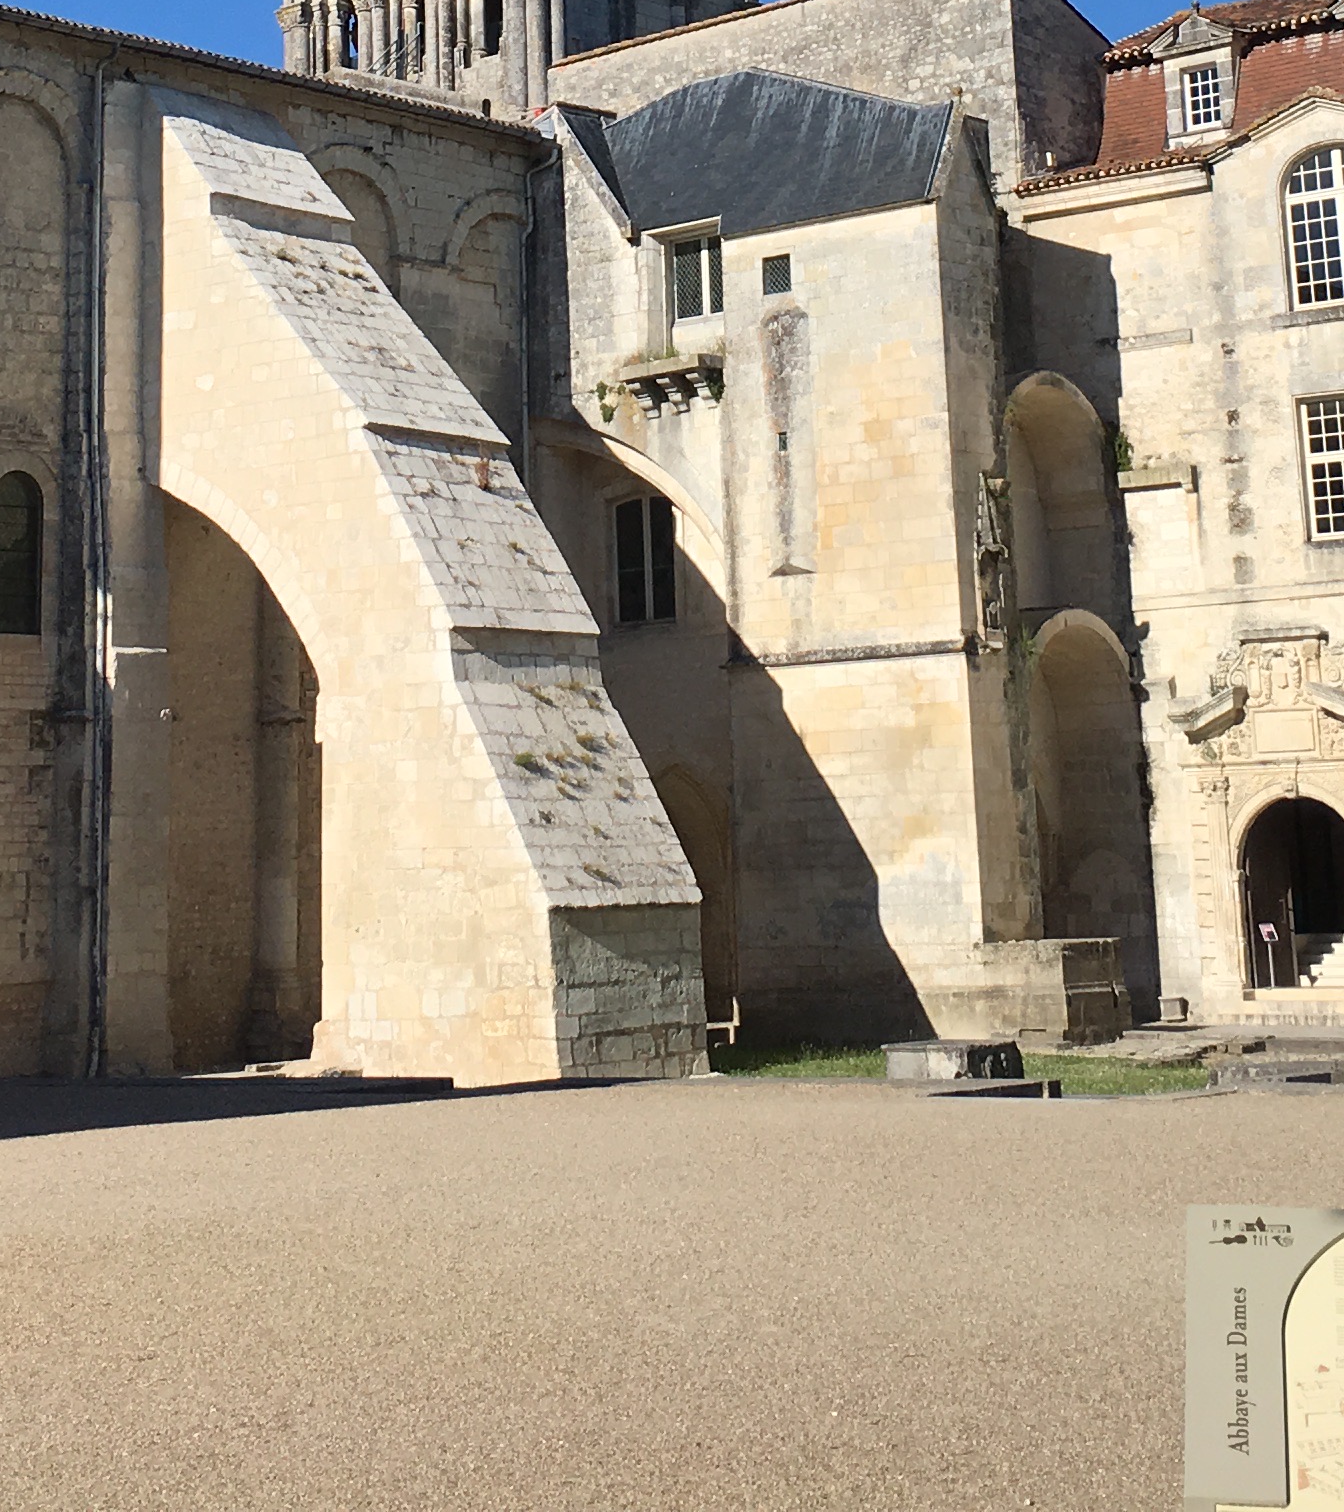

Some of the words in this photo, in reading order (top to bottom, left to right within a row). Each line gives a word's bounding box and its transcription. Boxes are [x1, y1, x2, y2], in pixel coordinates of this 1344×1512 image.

[1226, 1287, 1248, 1347] Dames
[1235, 1352, 1248, 1384] aux
[1227, 1388, 1256, 1456] Abbaye
